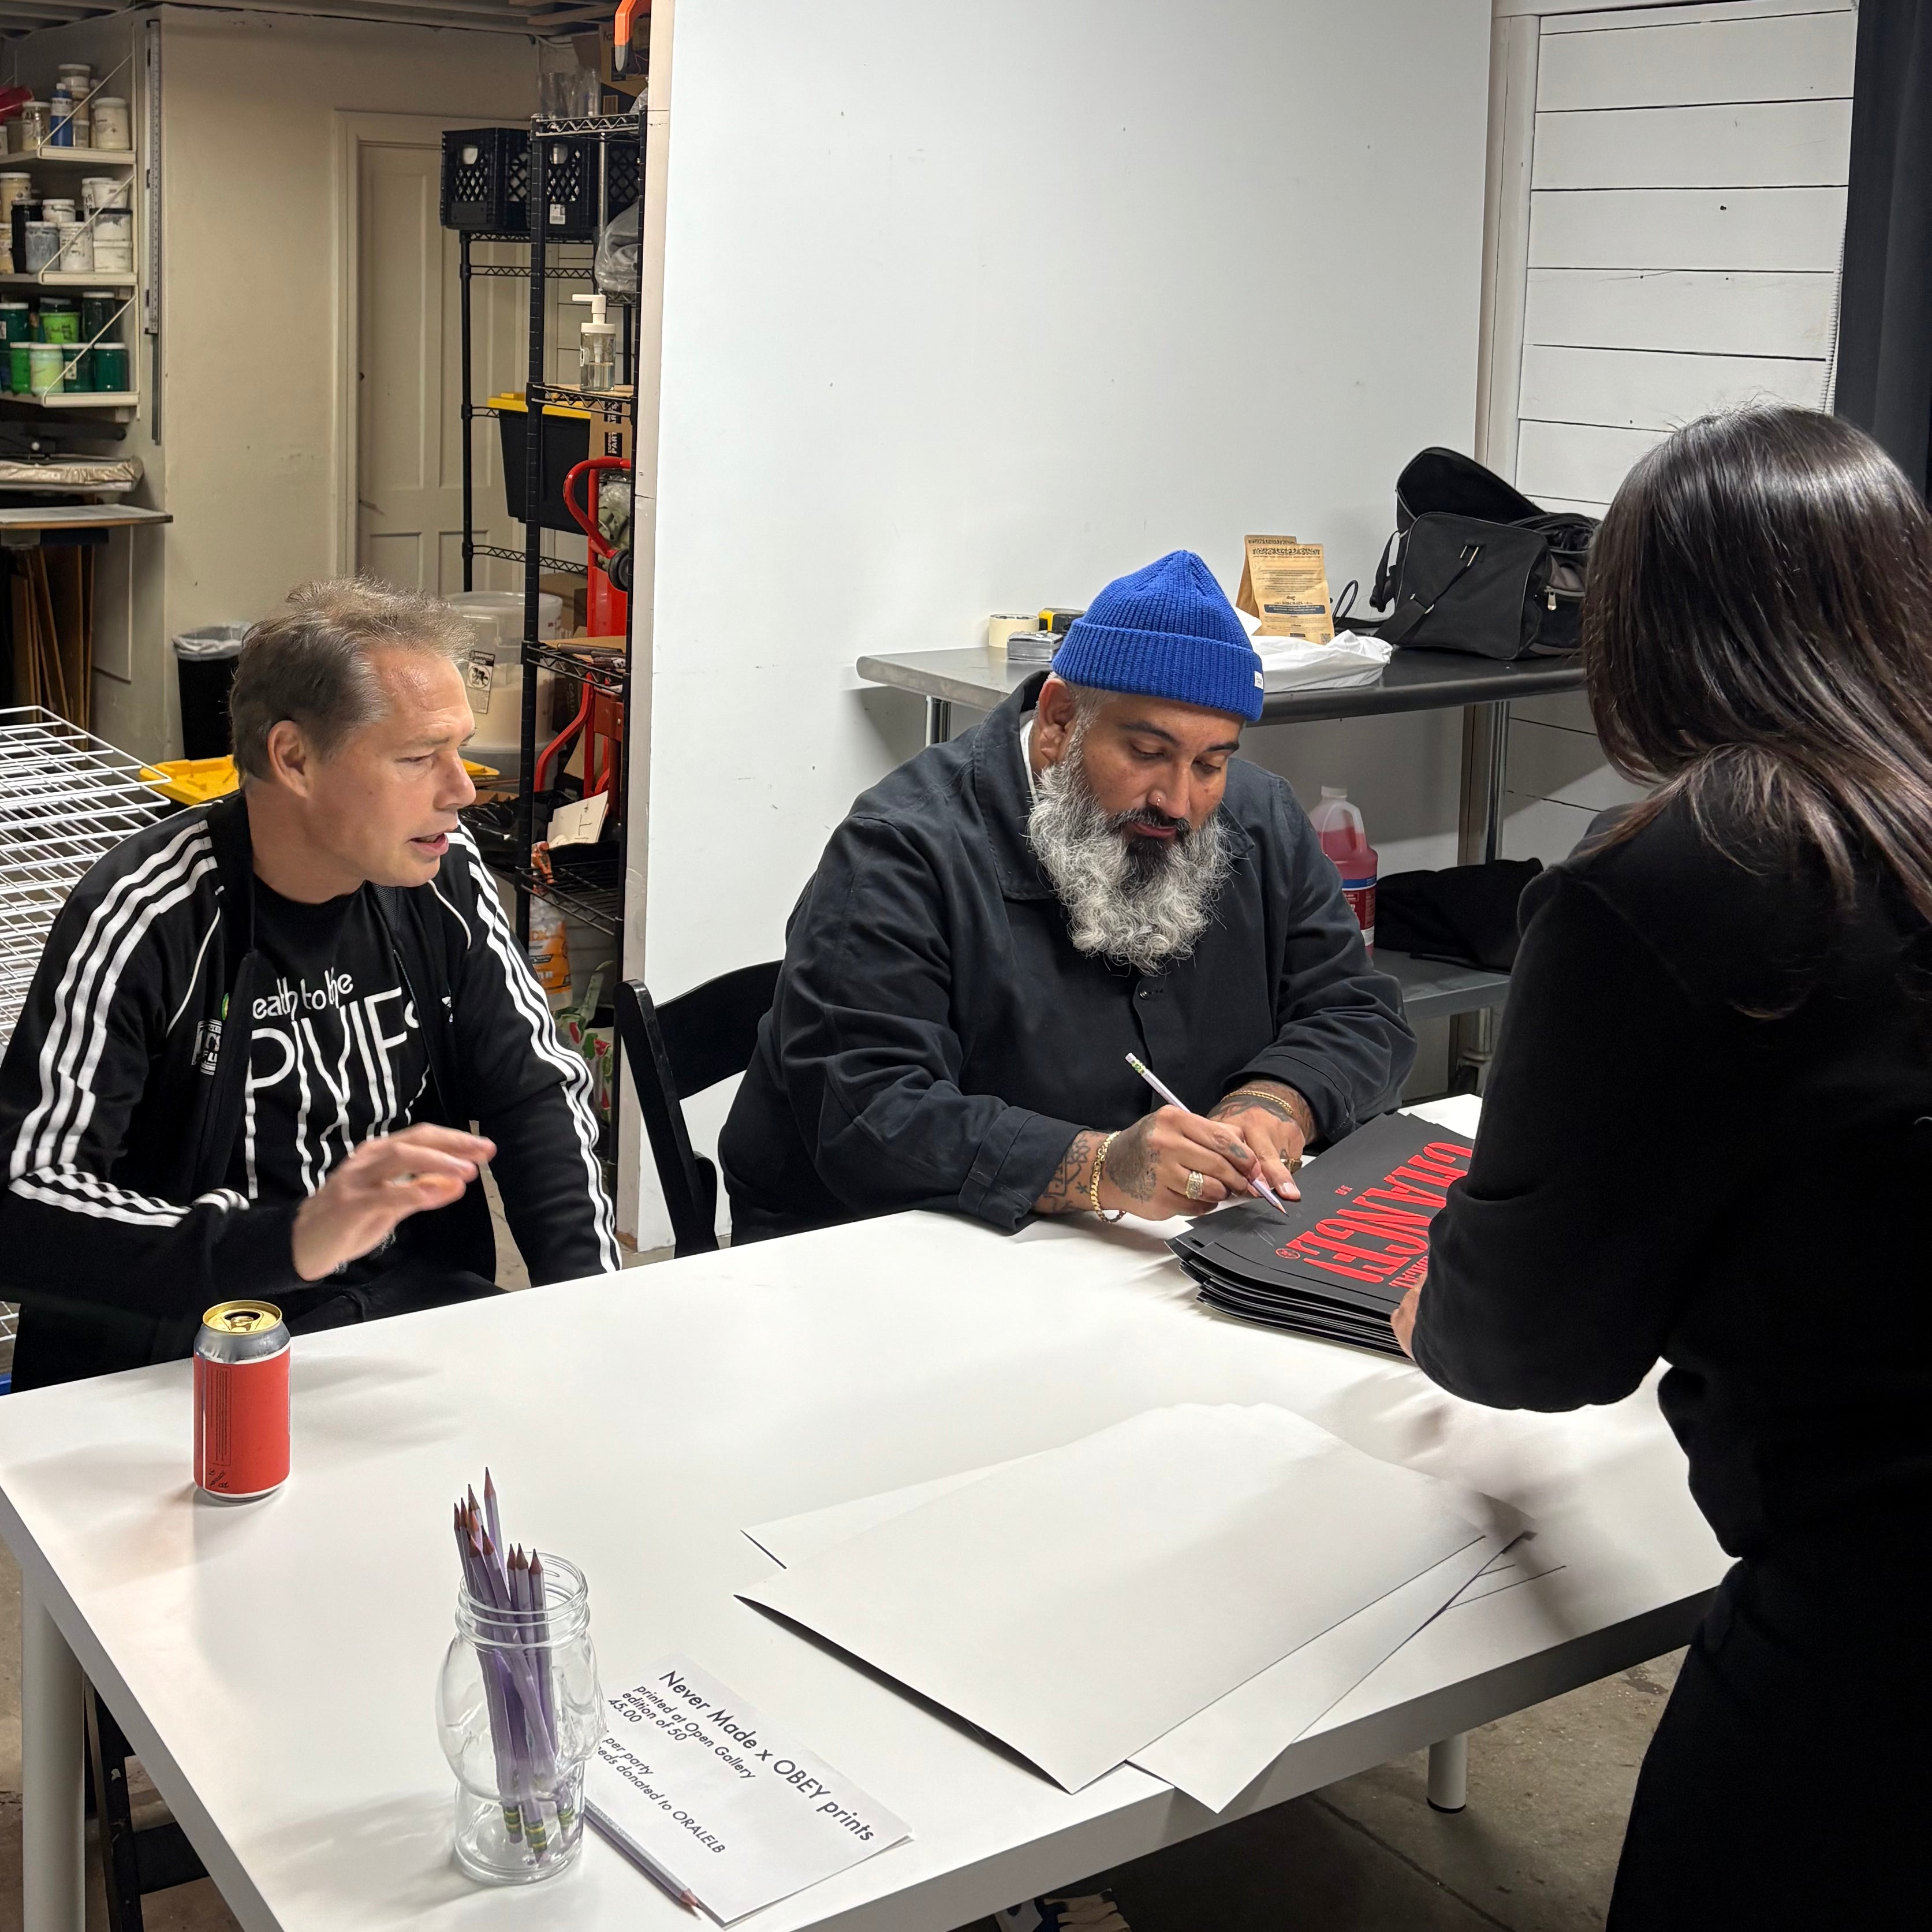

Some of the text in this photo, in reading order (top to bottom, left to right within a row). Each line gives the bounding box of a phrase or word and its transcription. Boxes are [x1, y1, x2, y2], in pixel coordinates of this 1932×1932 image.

[300, 978, 327, 1009] to
[325, 967, 353, 1009] the
[607, 1699, 642, 1722] 45.00
[622, 1692, 688, 1741] edition of 50
[632, 1685, 756, 1778] printed at Open Gallery
[602, 1737, 654, 1775] per party
[658, 1670, 874, 1841] Never Made x OBEY prints
[616, 1764, 665, 1800] donated
[658, 1800, 672, 1811] to
[672, 1811, 726, 1853] ORALELB
